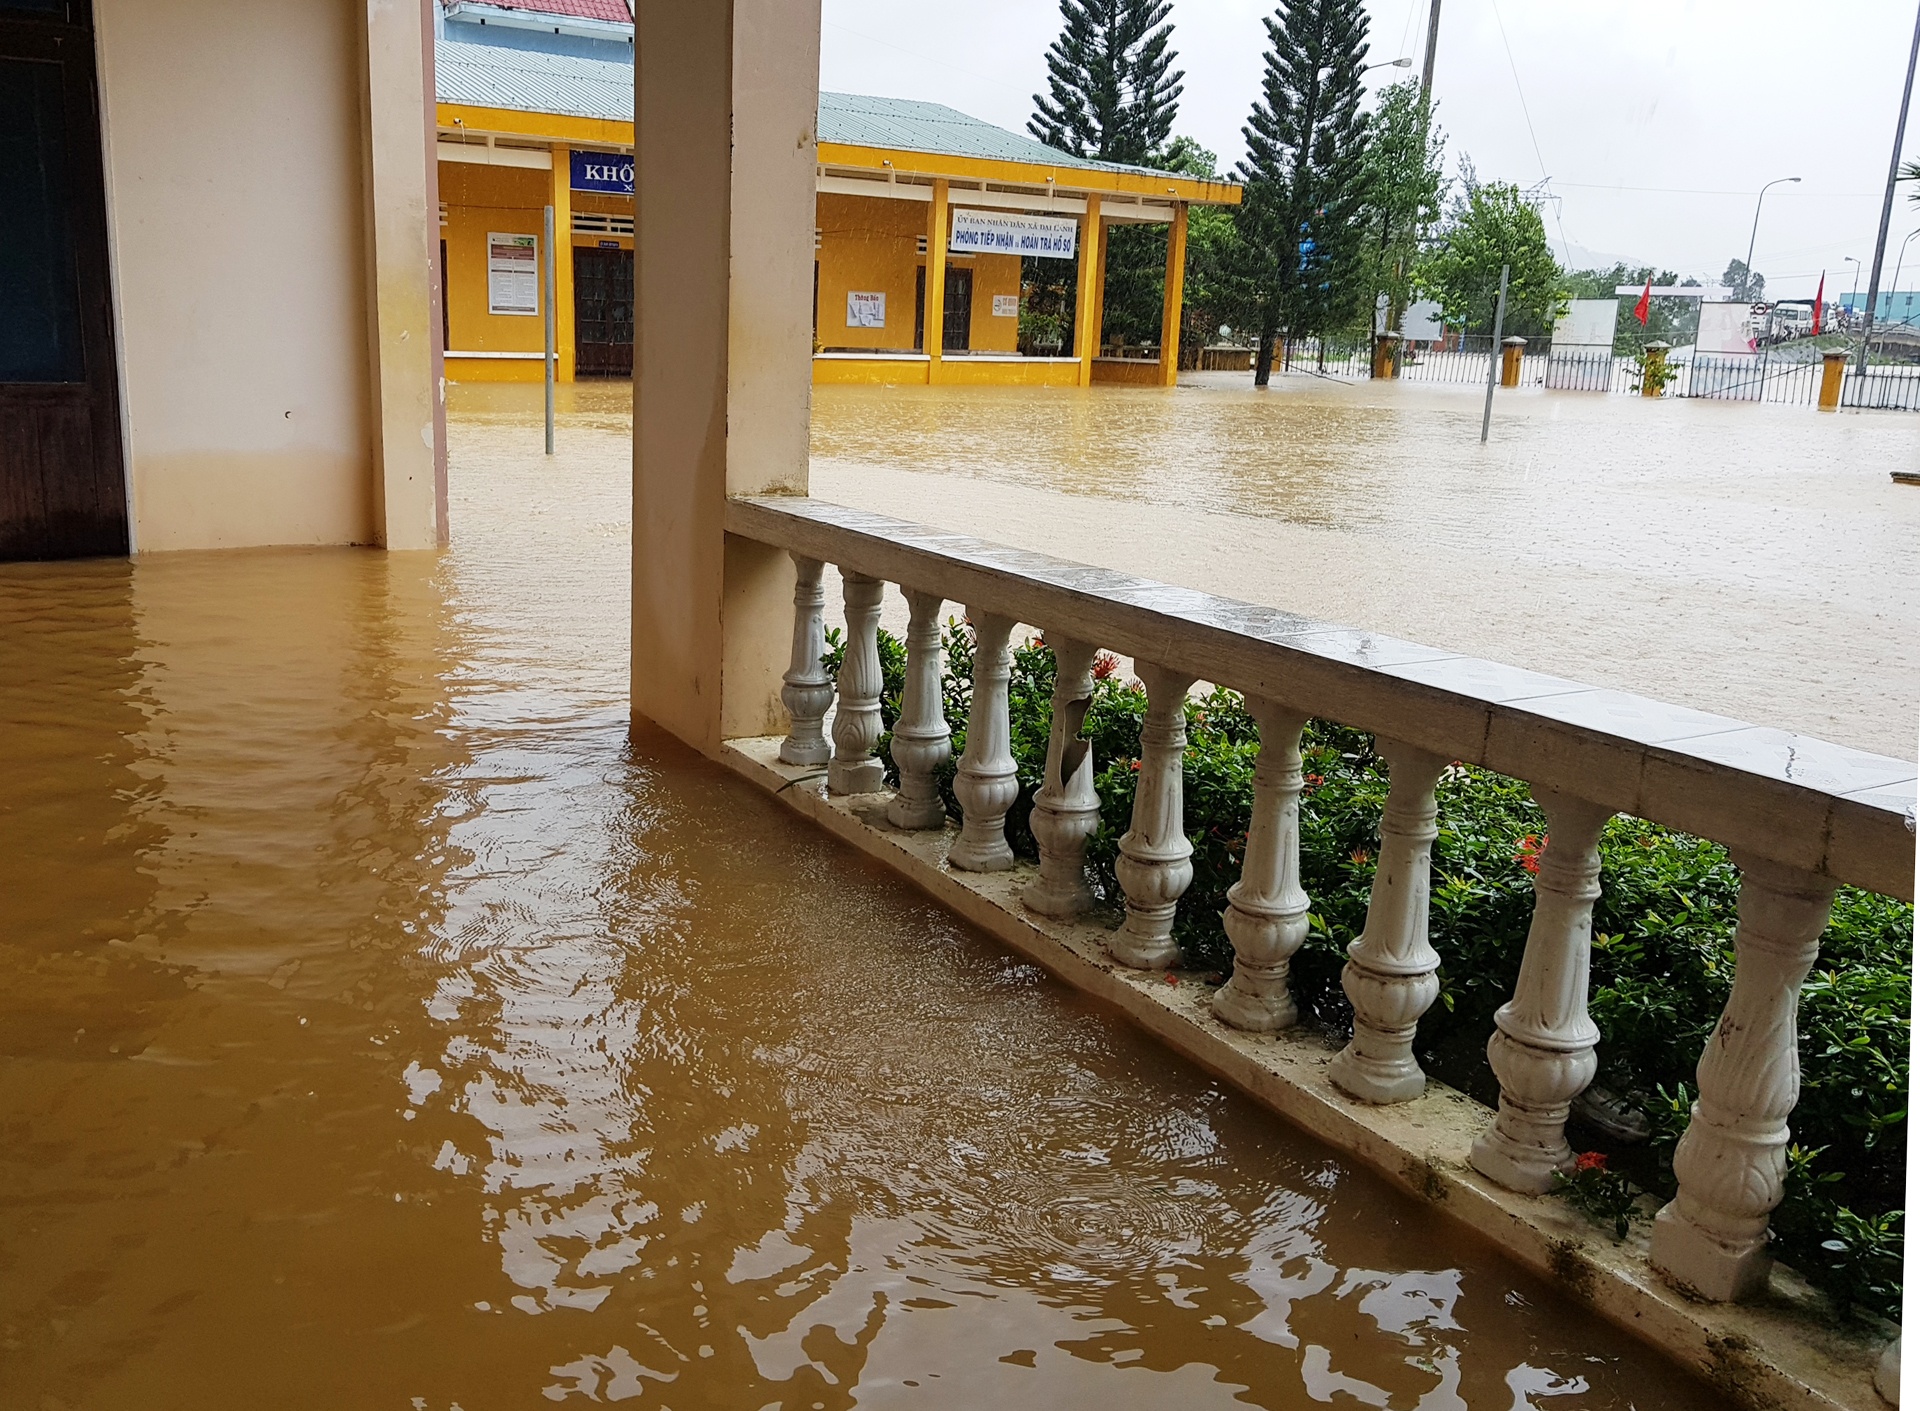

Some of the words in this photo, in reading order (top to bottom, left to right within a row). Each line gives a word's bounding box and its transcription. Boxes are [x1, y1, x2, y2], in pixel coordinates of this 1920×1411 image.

[969, 217, 986, 225] BAN
[1010, 220, 1026, 229] DÂN
[955, 227, 979, 245] PHÒNG
[980, 229, 995, 246] TIẾP
[995, 231, 1015, 251] NHẬN
[1020, 233, 1040, 250] HOÀN
[1040, 233, 1052, 251] TRẢ
[1063, 237, 1072, 253] SƠ
[854, 294, 870, 302] Thông
[870, 294, 879, 302] Báo
